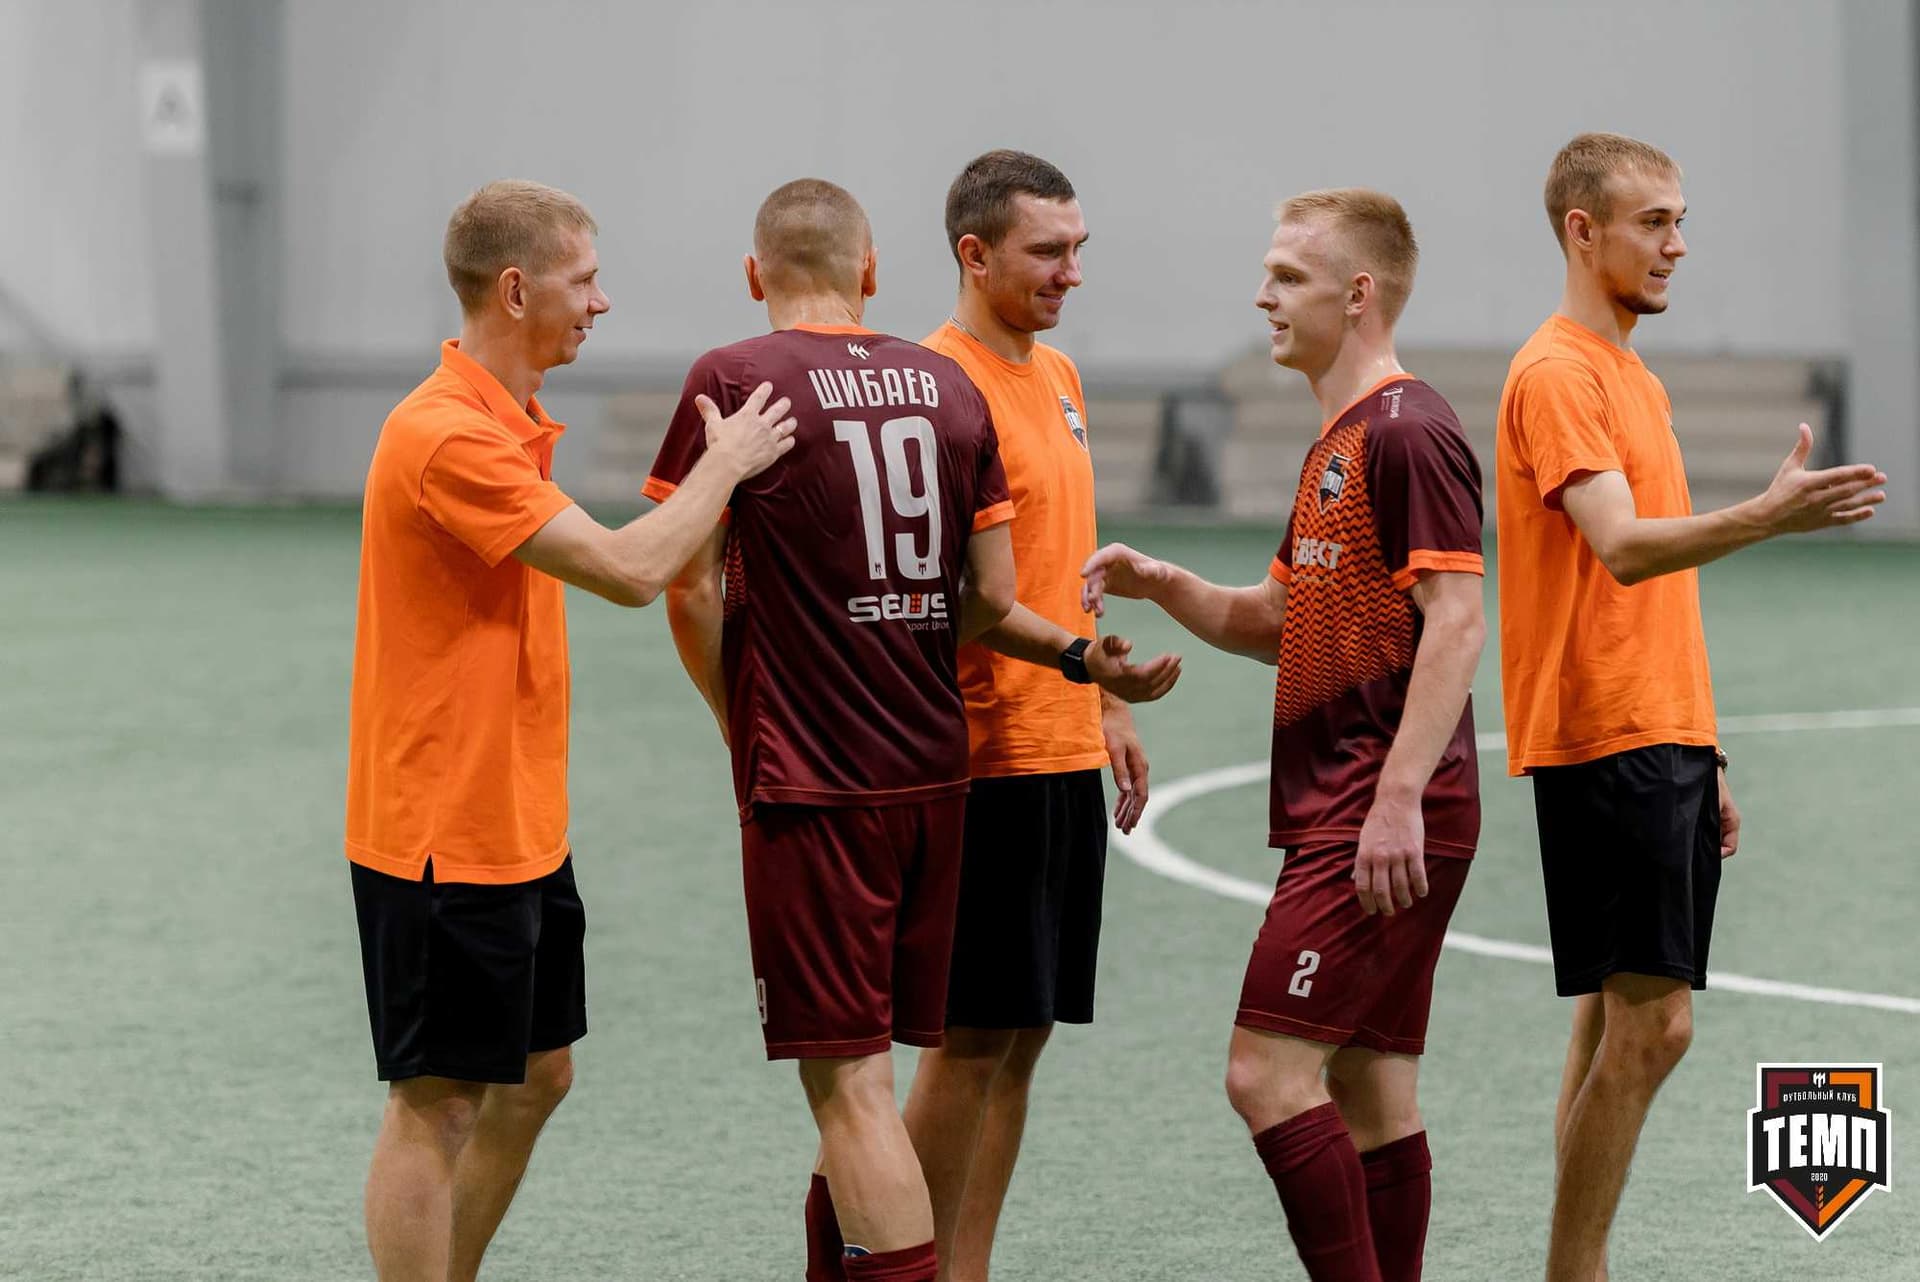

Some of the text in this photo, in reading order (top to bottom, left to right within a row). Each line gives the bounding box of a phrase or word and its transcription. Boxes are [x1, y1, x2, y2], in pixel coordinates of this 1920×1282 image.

[808, 367, 939, 410] ШИБАЕВ
[833, 416, 942, 580] 19
[1287, 949, 1321, 998] 2
